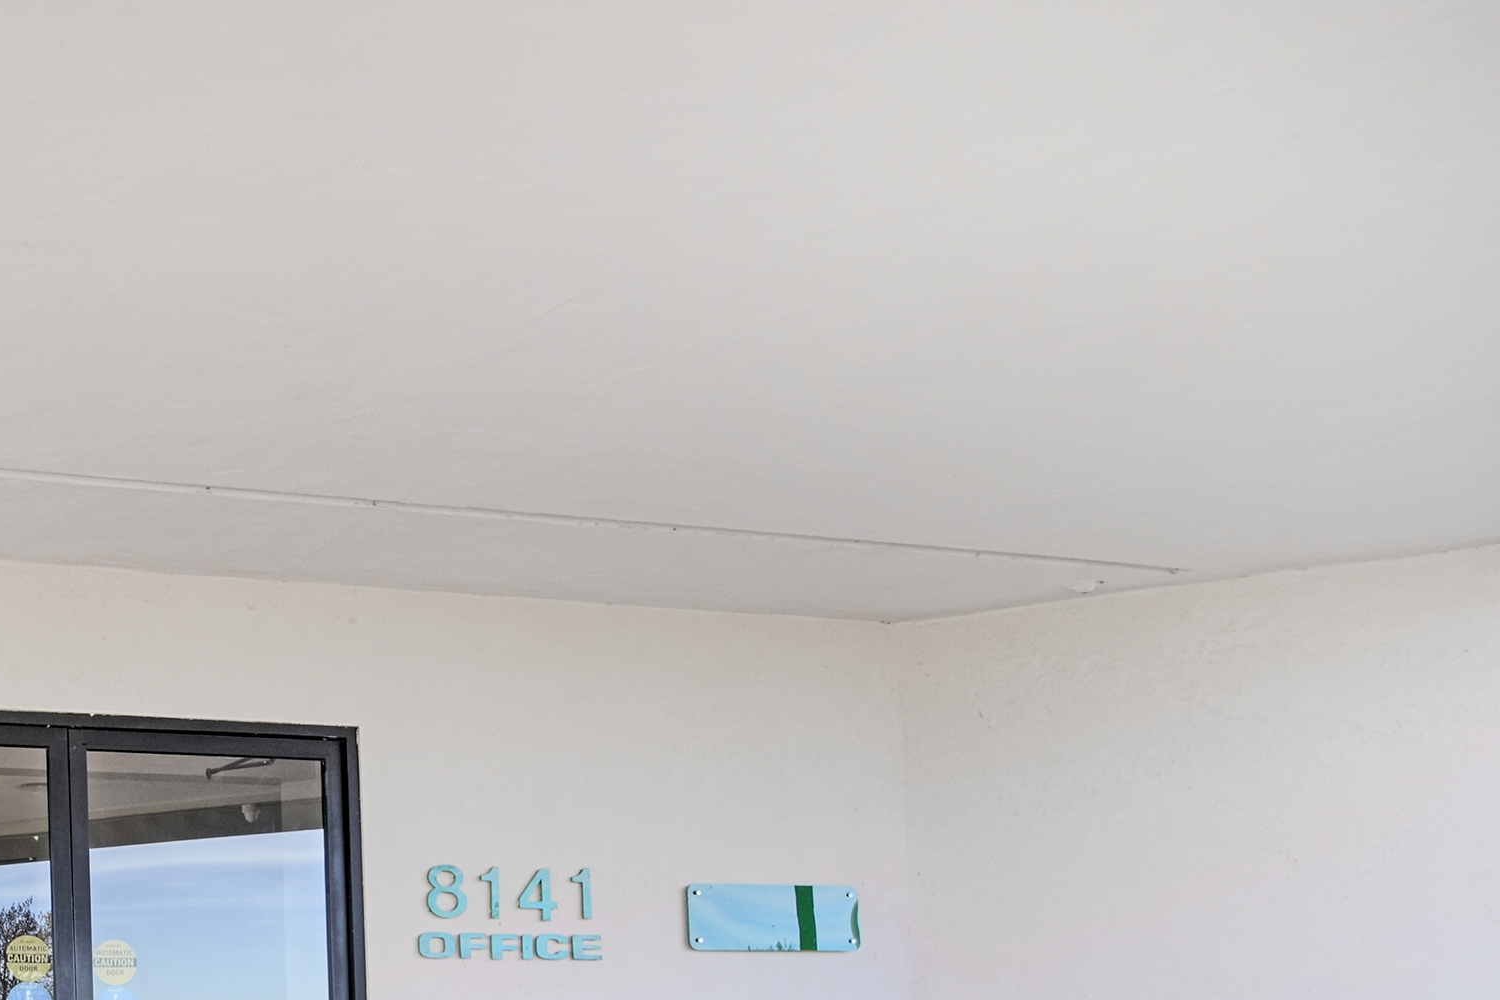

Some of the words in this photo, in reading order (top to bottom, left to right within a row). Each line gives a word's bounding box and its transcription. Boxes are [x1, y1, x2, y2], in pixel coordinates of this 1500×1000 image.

[426, 864, 593, 921] 8141
[418, 931, 603, 961] OFFICE
[7, 953, 49, 963] CAUTION
[94, 958, 134, 967] CAUTION
